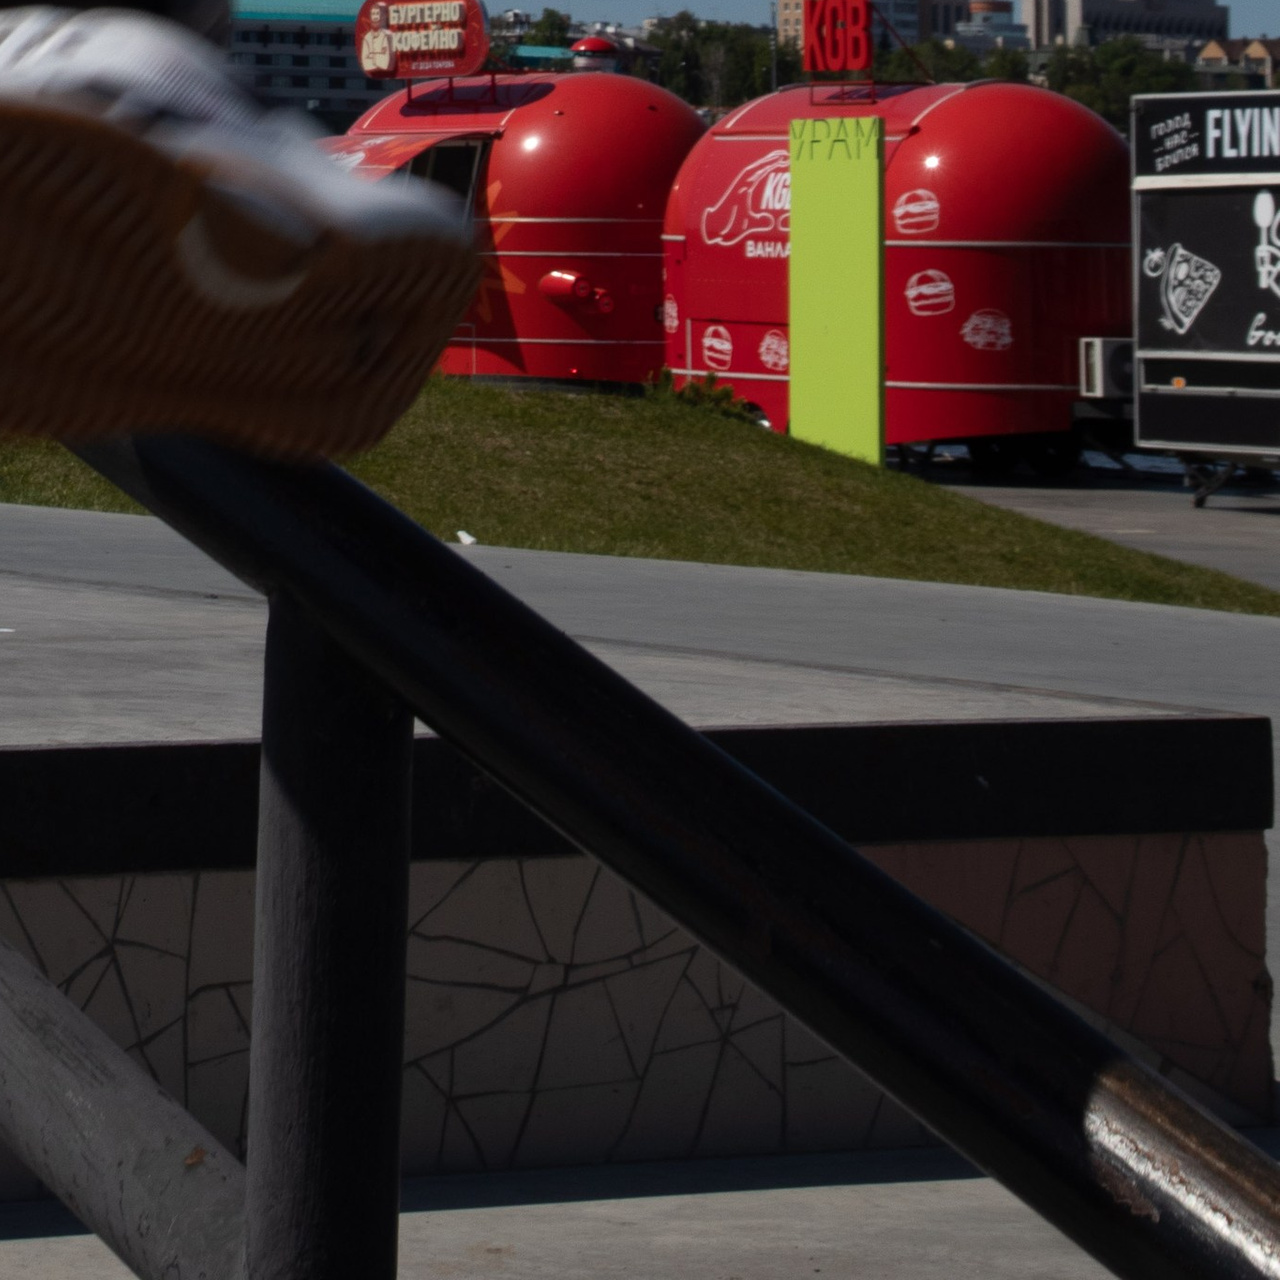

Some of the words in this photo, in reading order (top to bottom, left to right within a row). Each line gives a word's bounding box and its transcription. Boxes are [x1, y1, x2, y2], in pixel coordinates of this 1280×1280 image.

[388, 1, 463, 25] БУРГЕРНО
[391, 24, 462, 53] КОФЕЙНО
[790, 118, 880, 161] УРАМ
[1205, 106, 1280, 159] FLYIN
